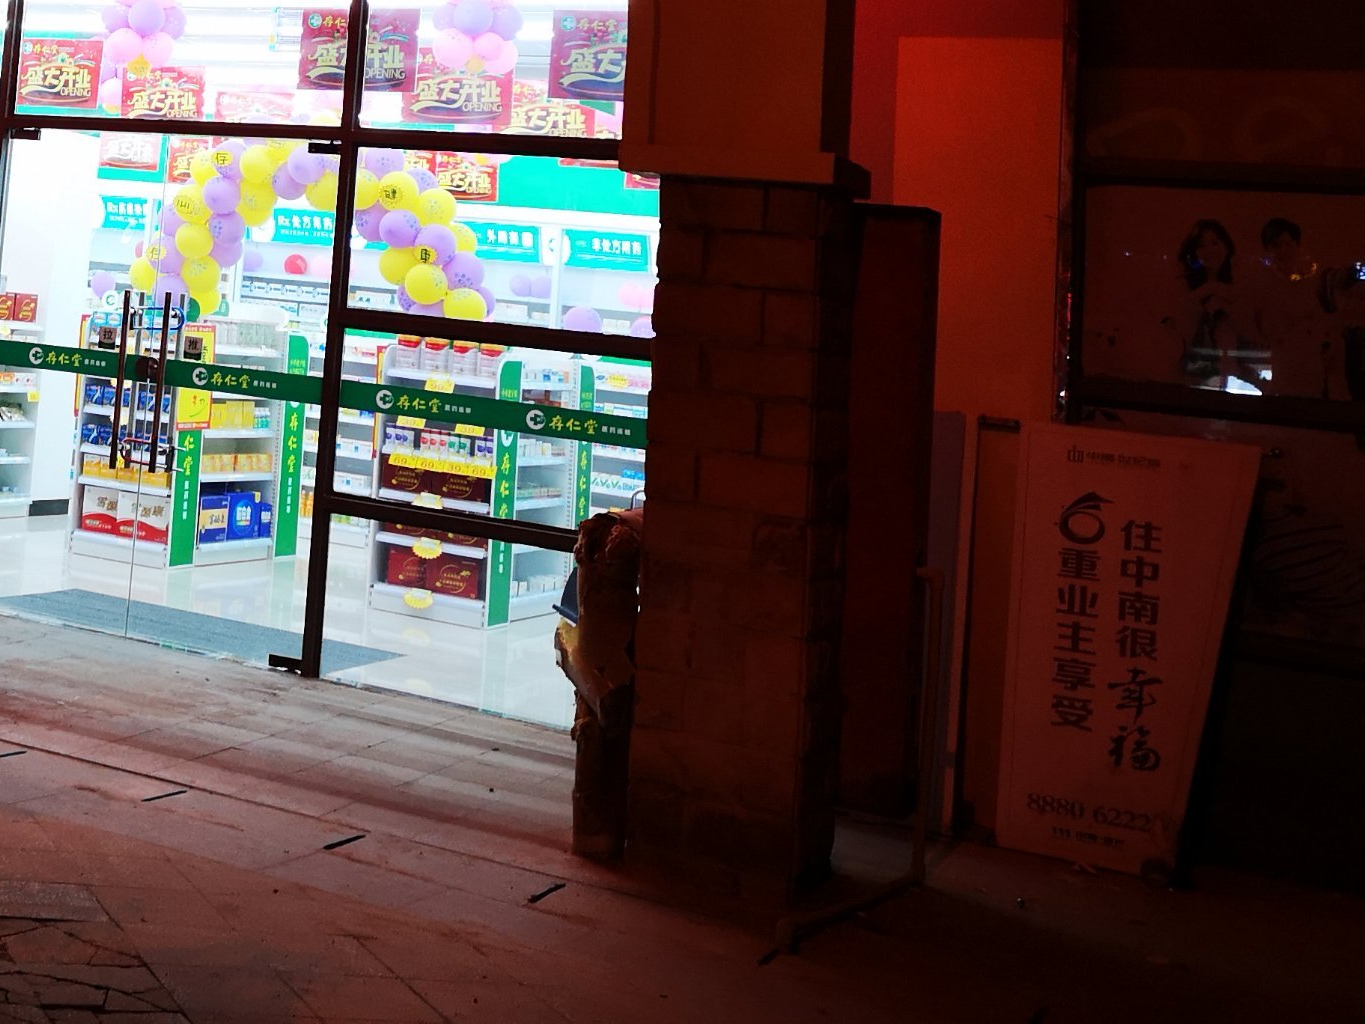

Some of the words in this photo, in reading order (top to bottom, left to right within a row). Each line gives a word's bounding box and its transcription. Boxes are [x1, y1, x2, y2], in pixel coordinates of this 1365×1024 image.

[21, 67, 91, 92] 盛大开业
[61, 88, 91, 97] OPENING
[128, 91, 197, 114] 盛大开业
[417, 79, 501, 106] 盛大开业
[166, 110, 197, 118] OPENING
[462, 101, 502, 113] OPENING
[46, 350, 83, 367] 存仁堂
[211, 371, 251, 389] 存仁堂
[397, 394, 442, 414] 存仁堂
[548, 414, 598, 435] 存仁堂
[286, 412, 299, 473] 存仁堂
[1107, 519, 1164, 772] 住中南很幸福
